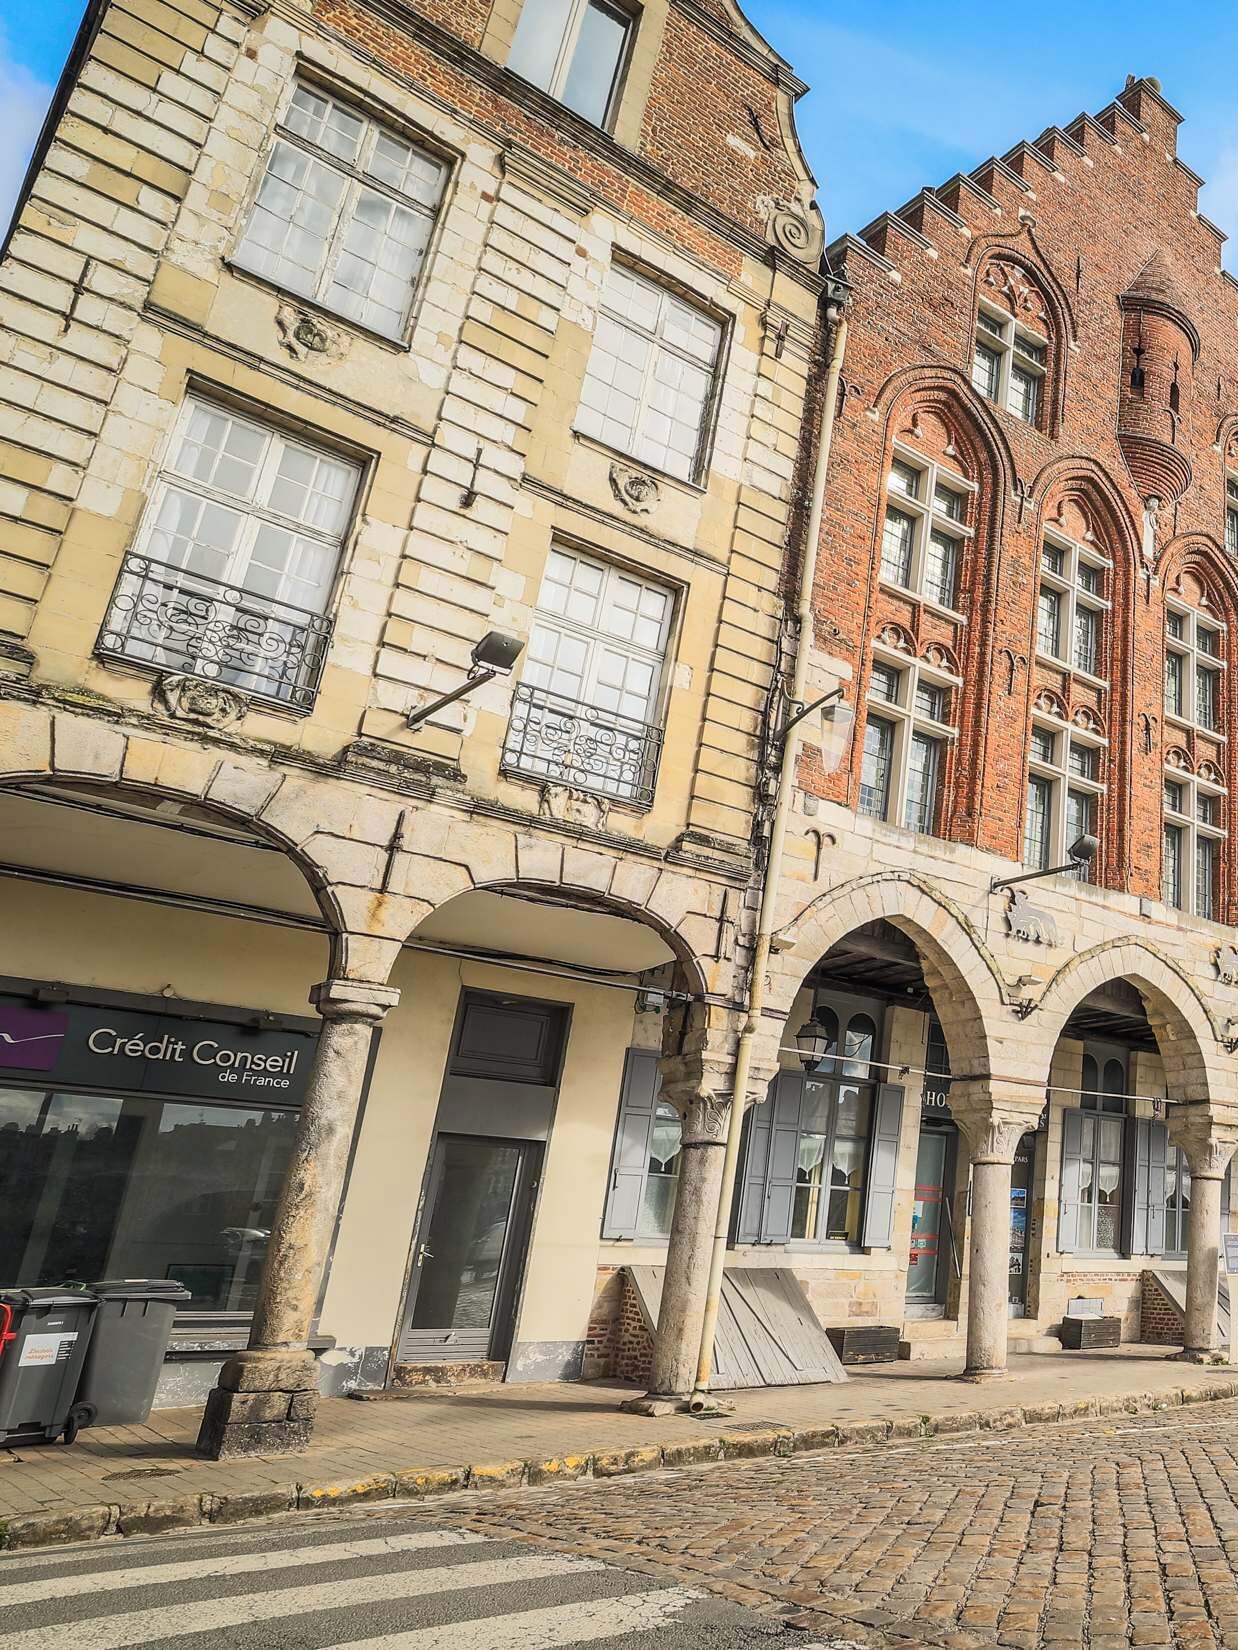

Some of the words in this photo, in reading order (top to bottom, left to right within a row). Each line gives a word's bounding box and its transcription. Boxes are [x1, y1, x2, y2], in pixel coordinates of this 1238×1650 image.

[88, 1028, 186, 1062] Crédit
[192, 1040, 299, 1074] Conseil
[218, 1069, 238, 1083] de
[242, 1072, 290, 1088] France
[925, 1090, 951, 1109] HO
[1014, 1155, 1029, 1163] PARS
